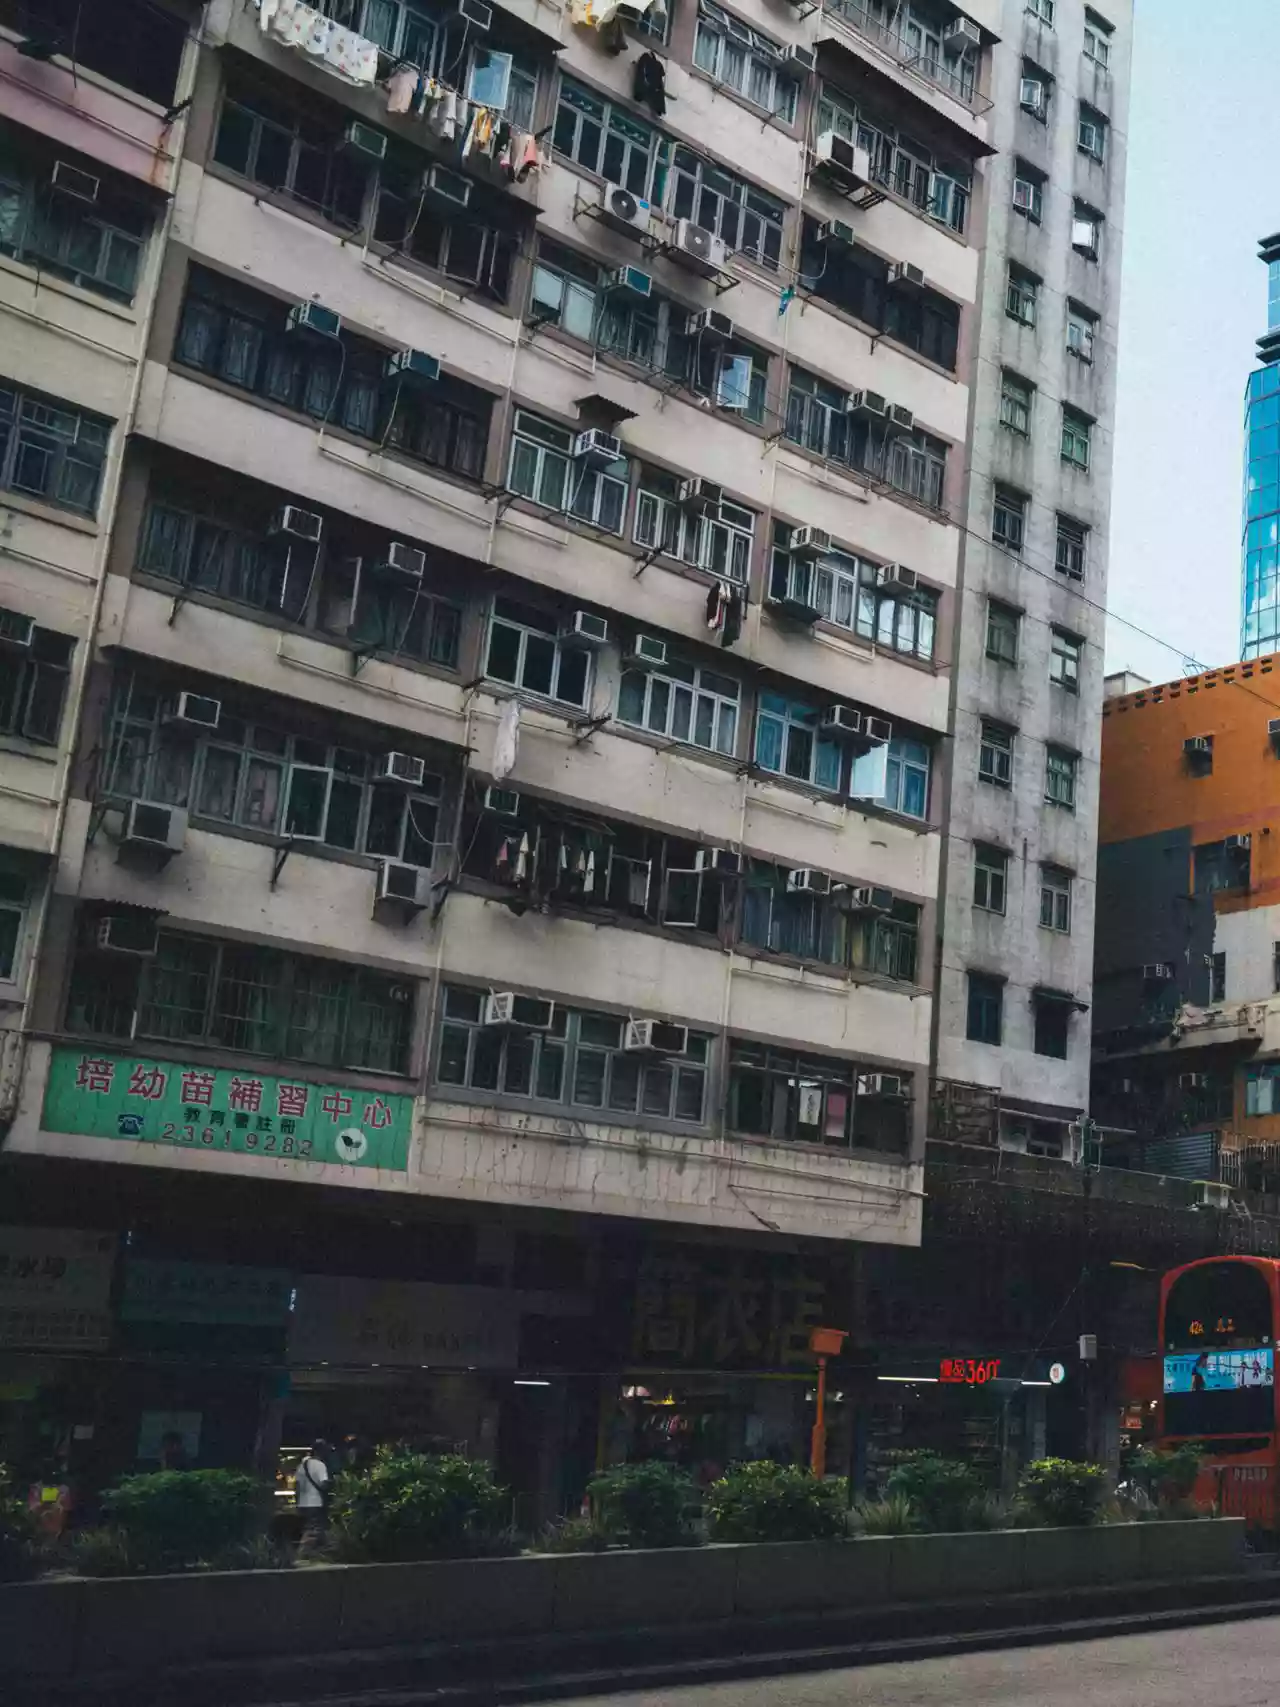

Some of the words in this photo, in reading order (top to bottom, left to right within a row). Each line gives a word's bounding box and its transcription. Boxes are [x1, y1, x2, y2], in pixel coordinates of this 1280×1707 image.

[75, 1055, 392, 1129] 培幼苗補習中心
[162, 1122, 232, 1148] 2361
[246, 1132, 313, 1157] 9282
